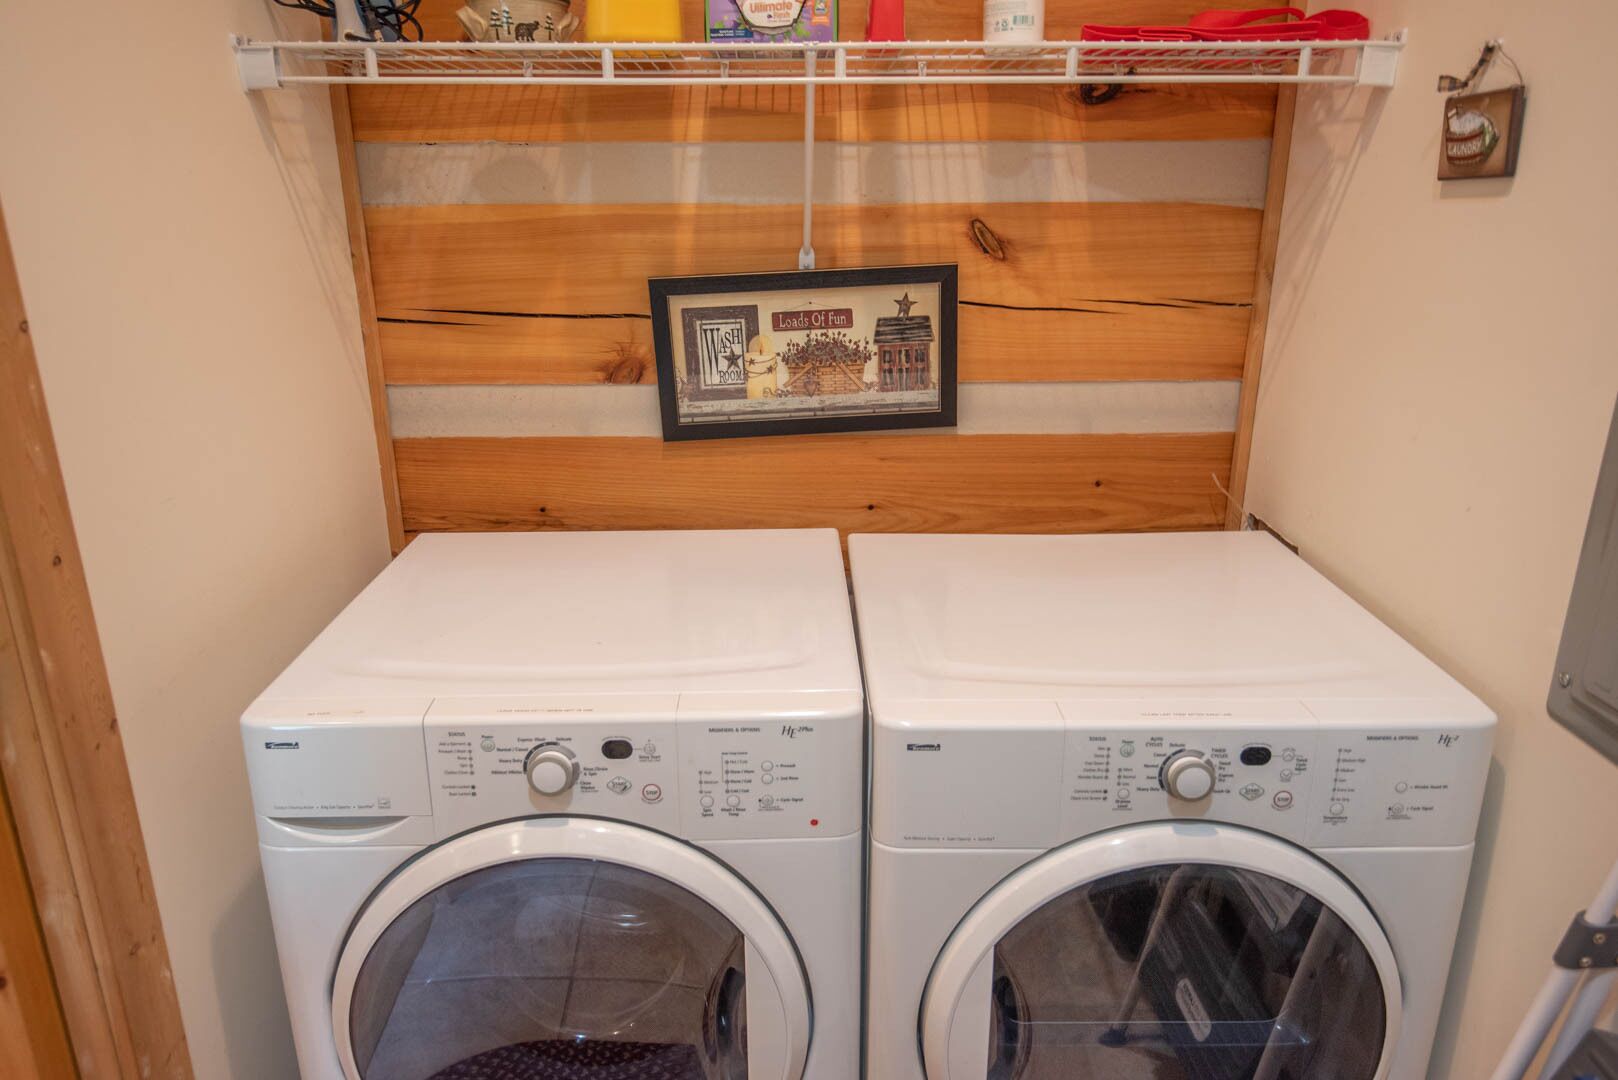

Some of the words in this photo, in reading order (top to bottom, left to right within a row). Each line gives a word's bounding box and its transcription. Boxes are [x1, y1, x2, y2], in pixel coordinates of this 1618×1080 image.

[1448, 141, 1482, 155] LAUNDRY
[779, 312, 809, 328] Loads
[811, 311, 825, 327] Of
[828, 311, 847, 326] Fun
[719, 370, 743, 383] ROOM
